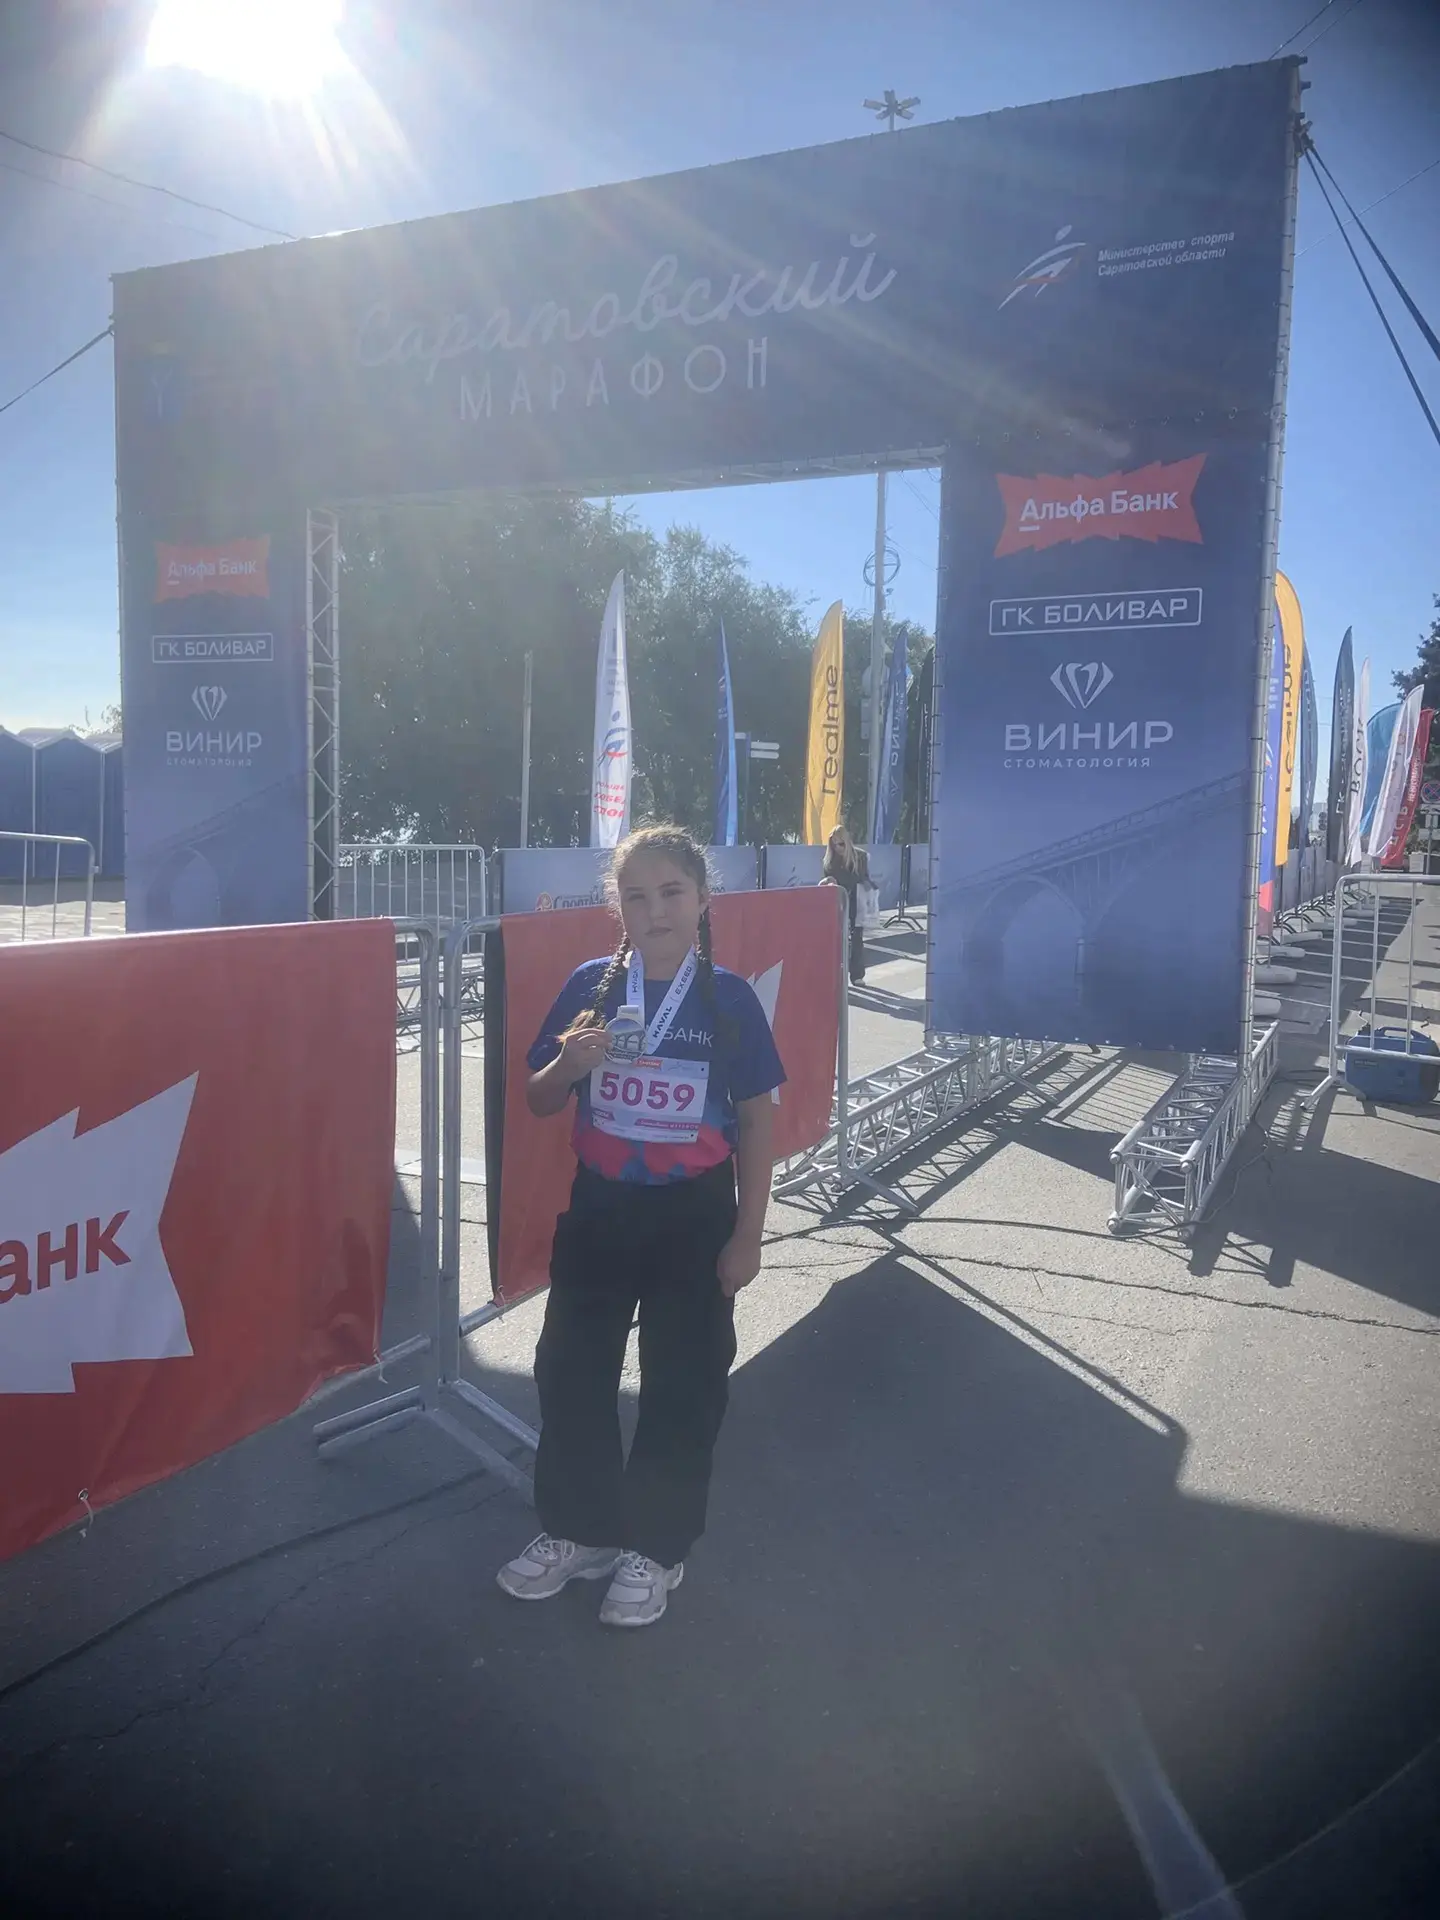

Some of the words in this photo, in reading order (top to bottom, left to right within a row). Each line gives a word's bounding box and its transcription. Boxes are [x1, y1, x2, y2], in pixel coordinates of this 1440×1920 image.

[1098, 240, 1185, 262] Министерство
[1191, 232, 1235, 248] спорта
[1098, 253, 1172, 276] Саратовской
[1175, 248, 1226, 263] области
[356, 231, 898, 384] Саратовский
[459, 336, 768, 421] МАРАФОН
[1019, 494, 1104, 532] Альфа
[1111, 489, 1179, 514] Банк
[167, 560, 215, 585] Альфа
[219, 558, 257, 575] Банк
[1002, 607, 1034, 626] ГК
[1044, 598, 1188, 624] БОЛИВАР
[159, 642, 180, 656] ГК
[185, 640, 266, 656] БОЛИВАР
[166, 731, 263, 752] ВИНИР
[821, 664, 838, 795] realme
[1004, 721, 1174, 751] ВИНИР
[1003, 757, 1151, 769] СТОМАТОЛОГИЯ
[674, 965, 693, 996] EXEED
[652, 1005, 673, 1039] HAVAL
[599, 1071, 696, 1112] 5059
